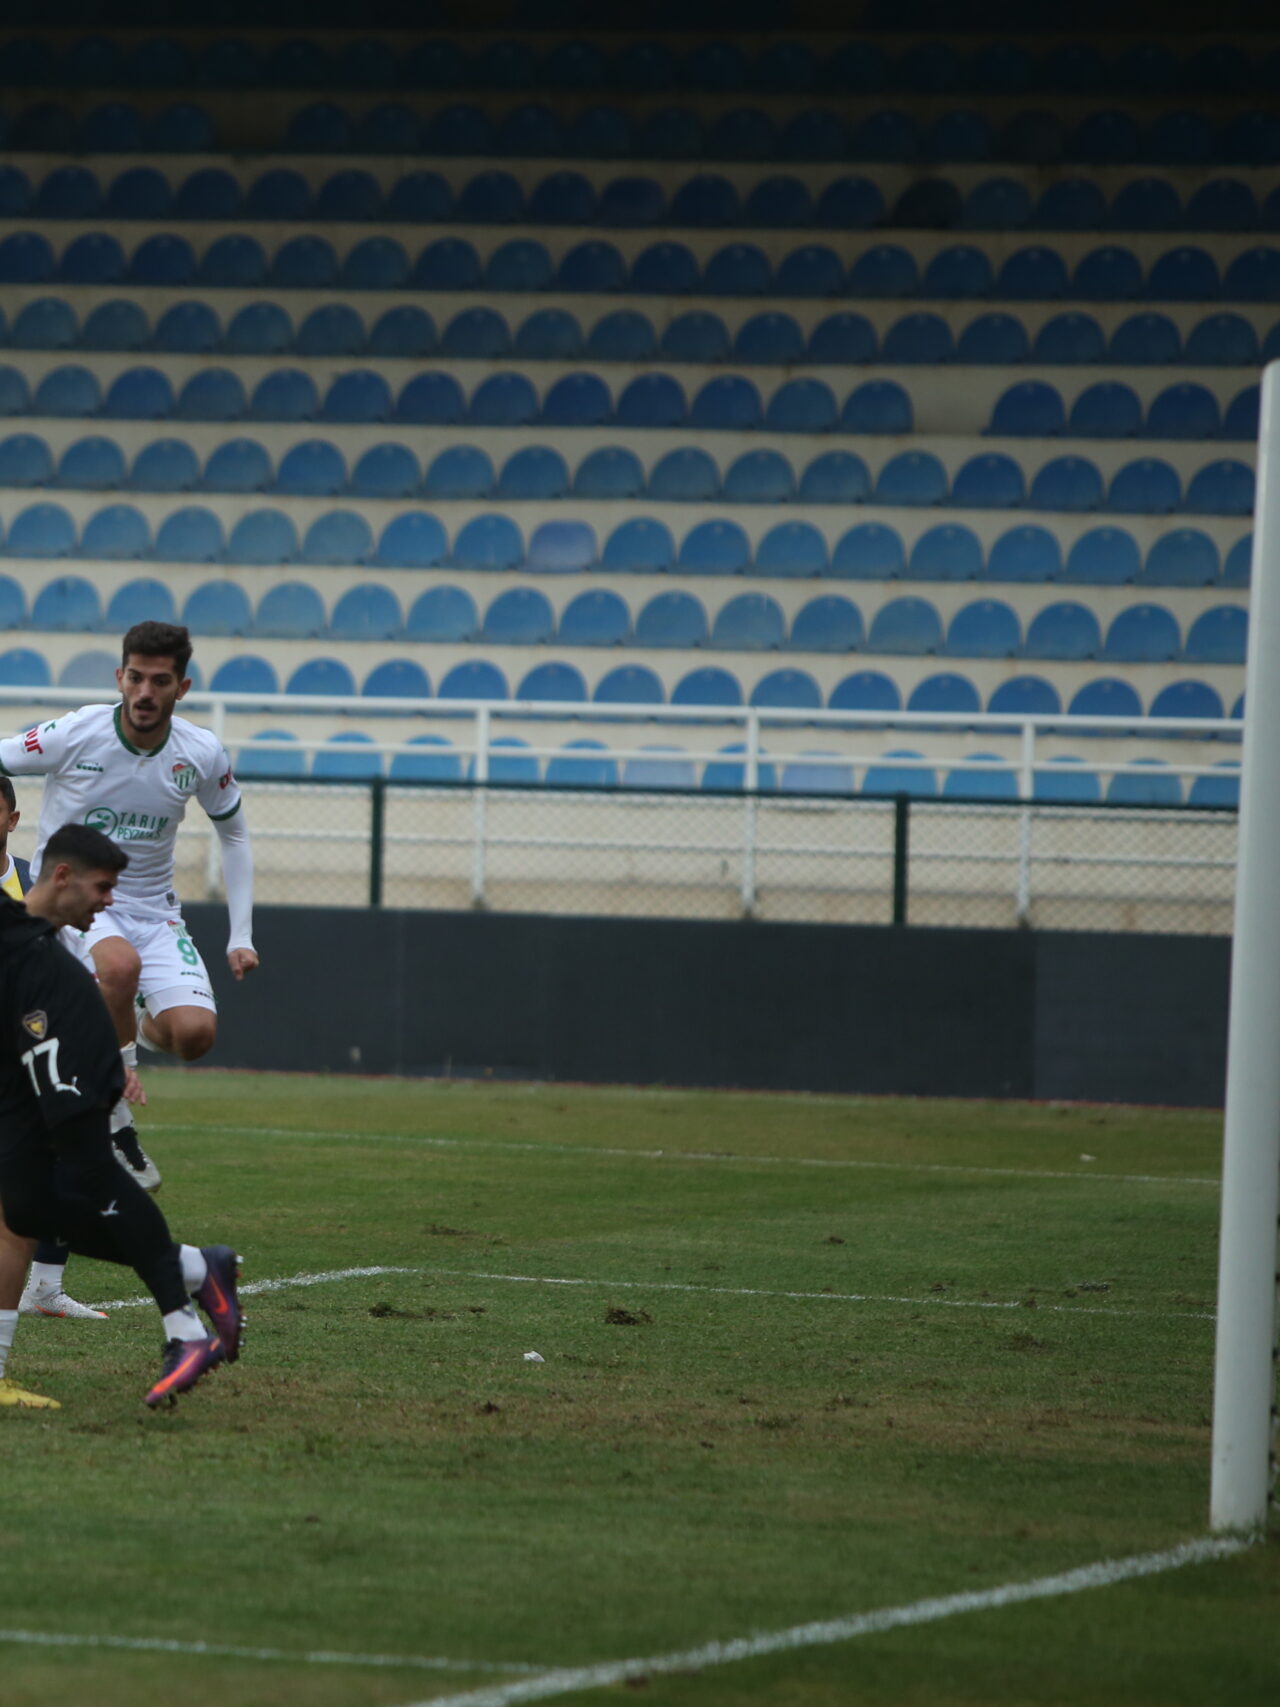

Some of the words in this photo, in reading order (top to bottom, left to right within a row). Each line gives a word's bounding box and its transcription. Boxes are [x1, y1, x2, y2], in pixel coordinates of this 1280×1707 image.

[120, 811, 169, 830] TARIM
[177, 937, 198, 967] 9
[21, 1037, 61, 1097] 17
